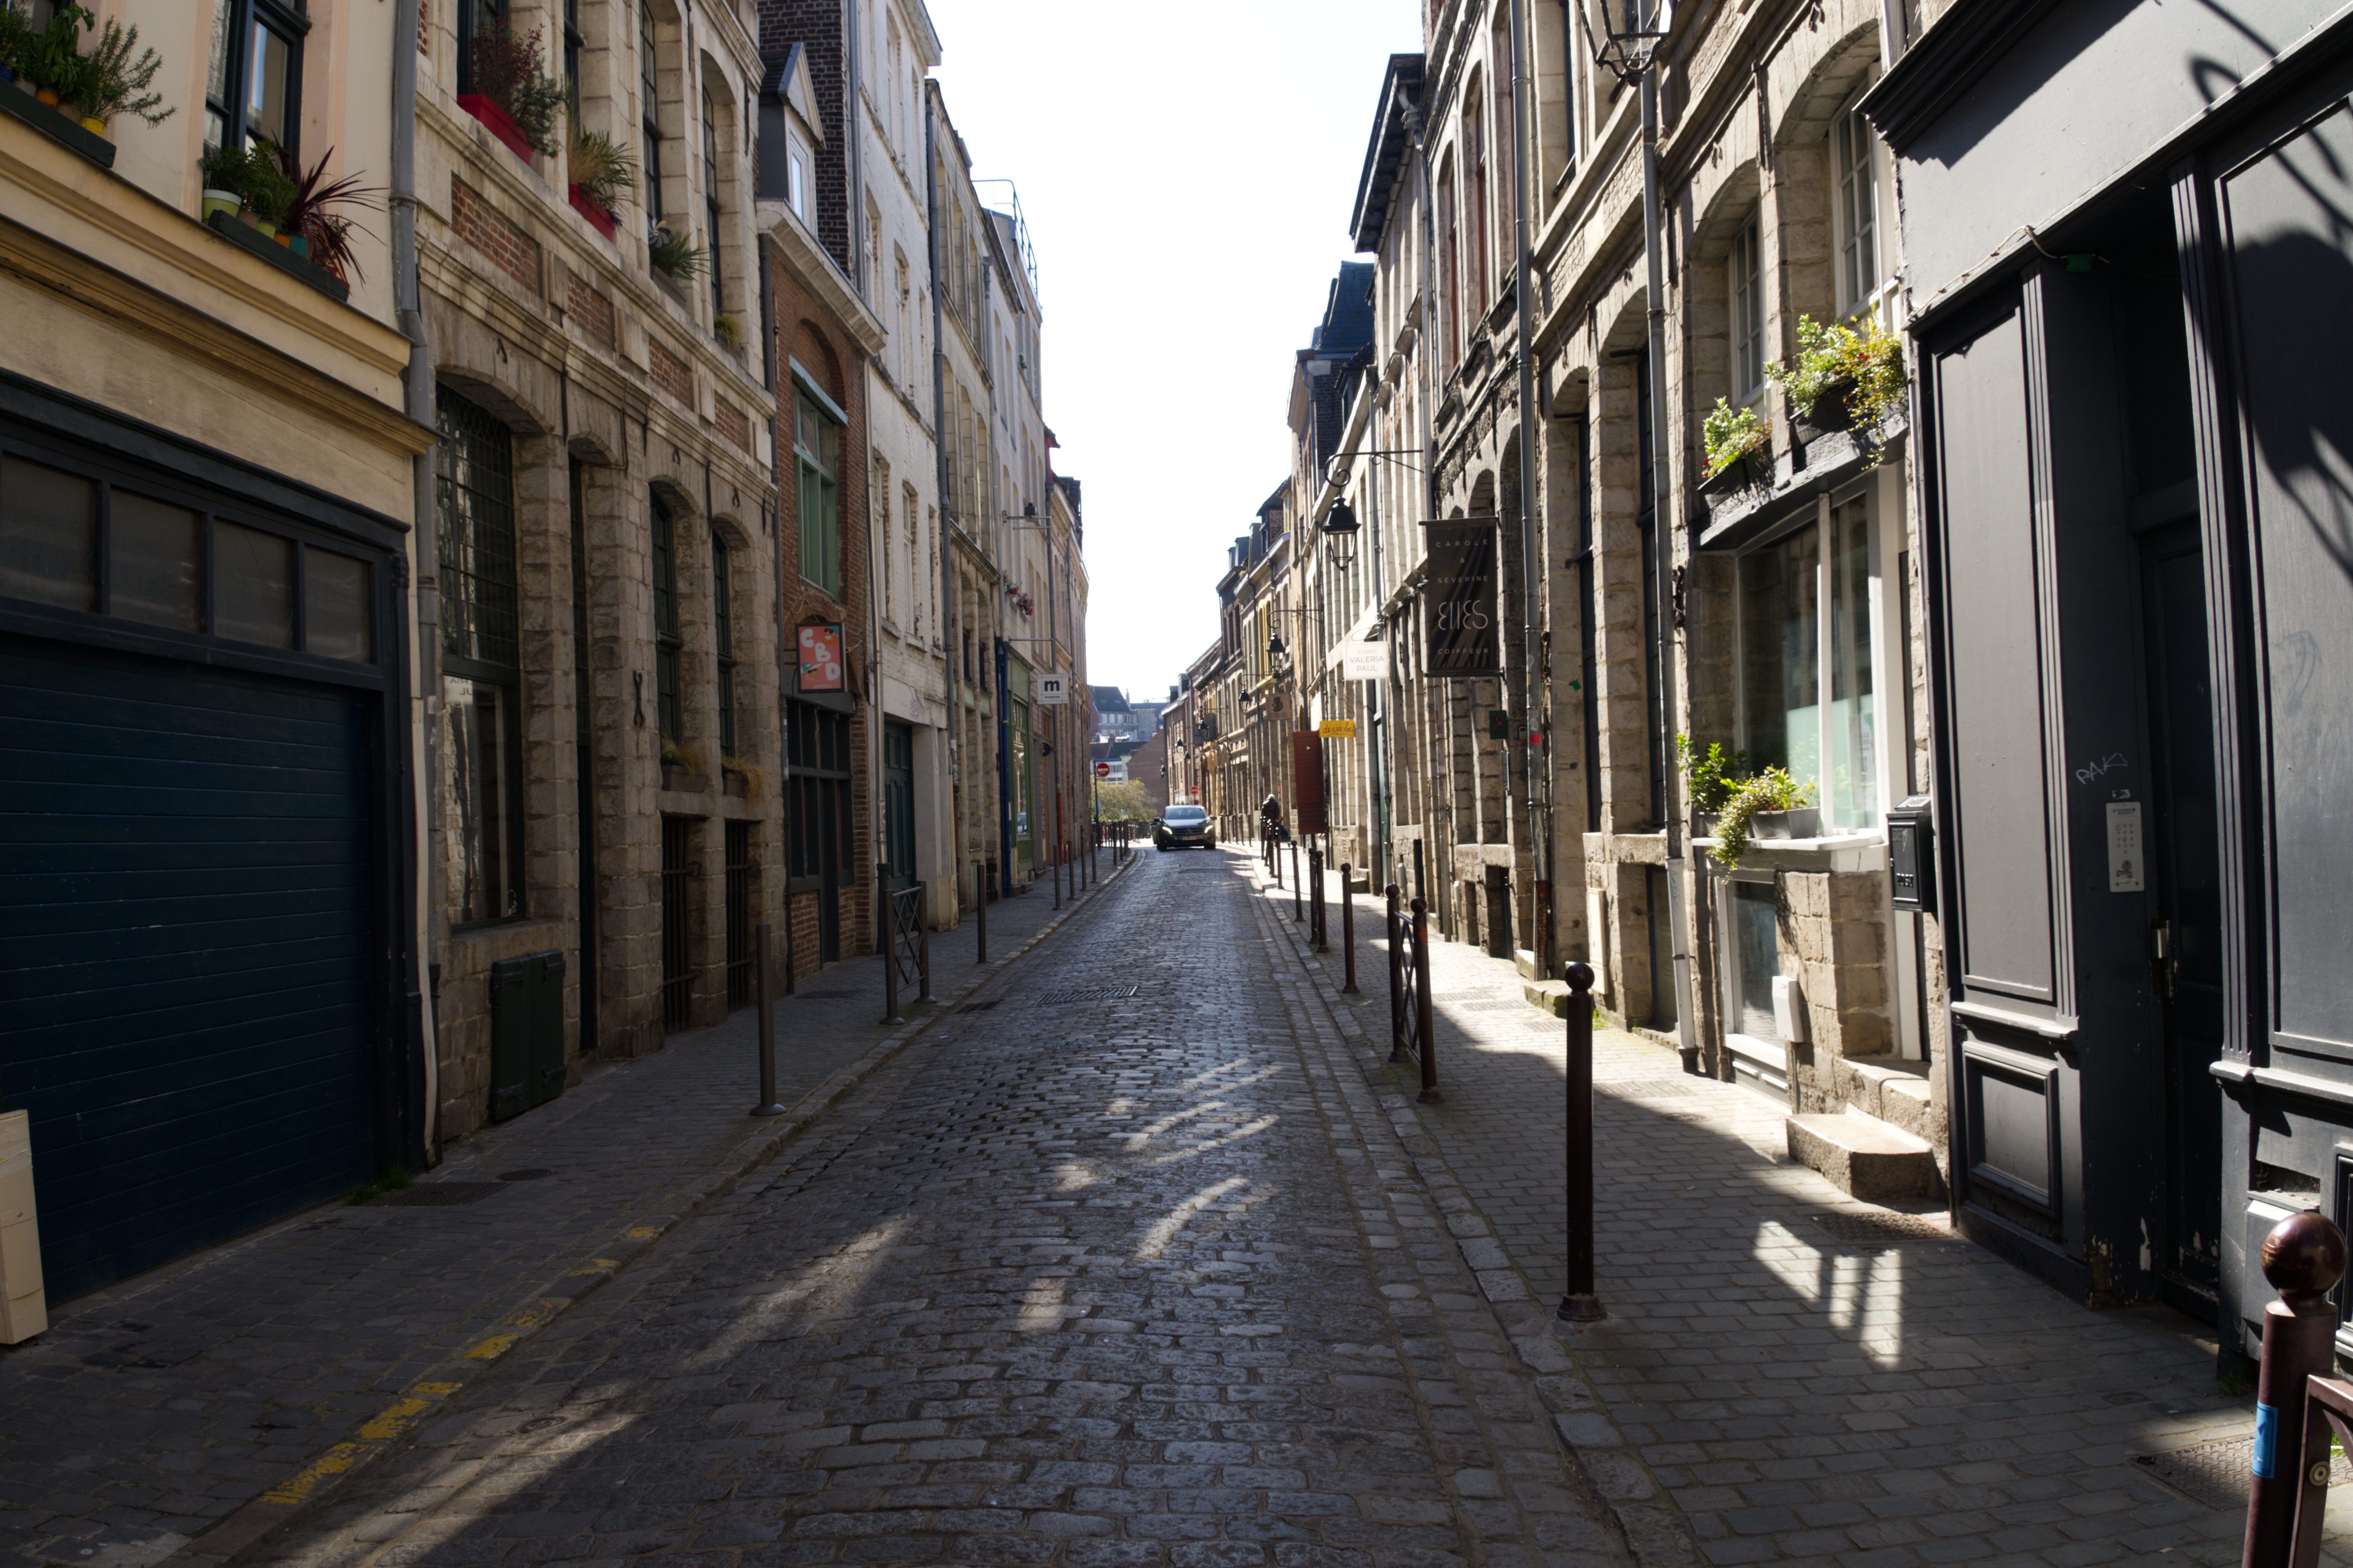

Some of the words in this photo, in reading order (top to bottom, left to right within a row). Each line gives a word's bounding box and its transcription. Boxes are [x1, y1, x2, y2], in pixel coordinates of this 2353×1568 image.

[1436, 539, 1488, 548] CAROLE
[1044, 680, 1060, 691] m
[1896, 873, 1914, 888] POST
